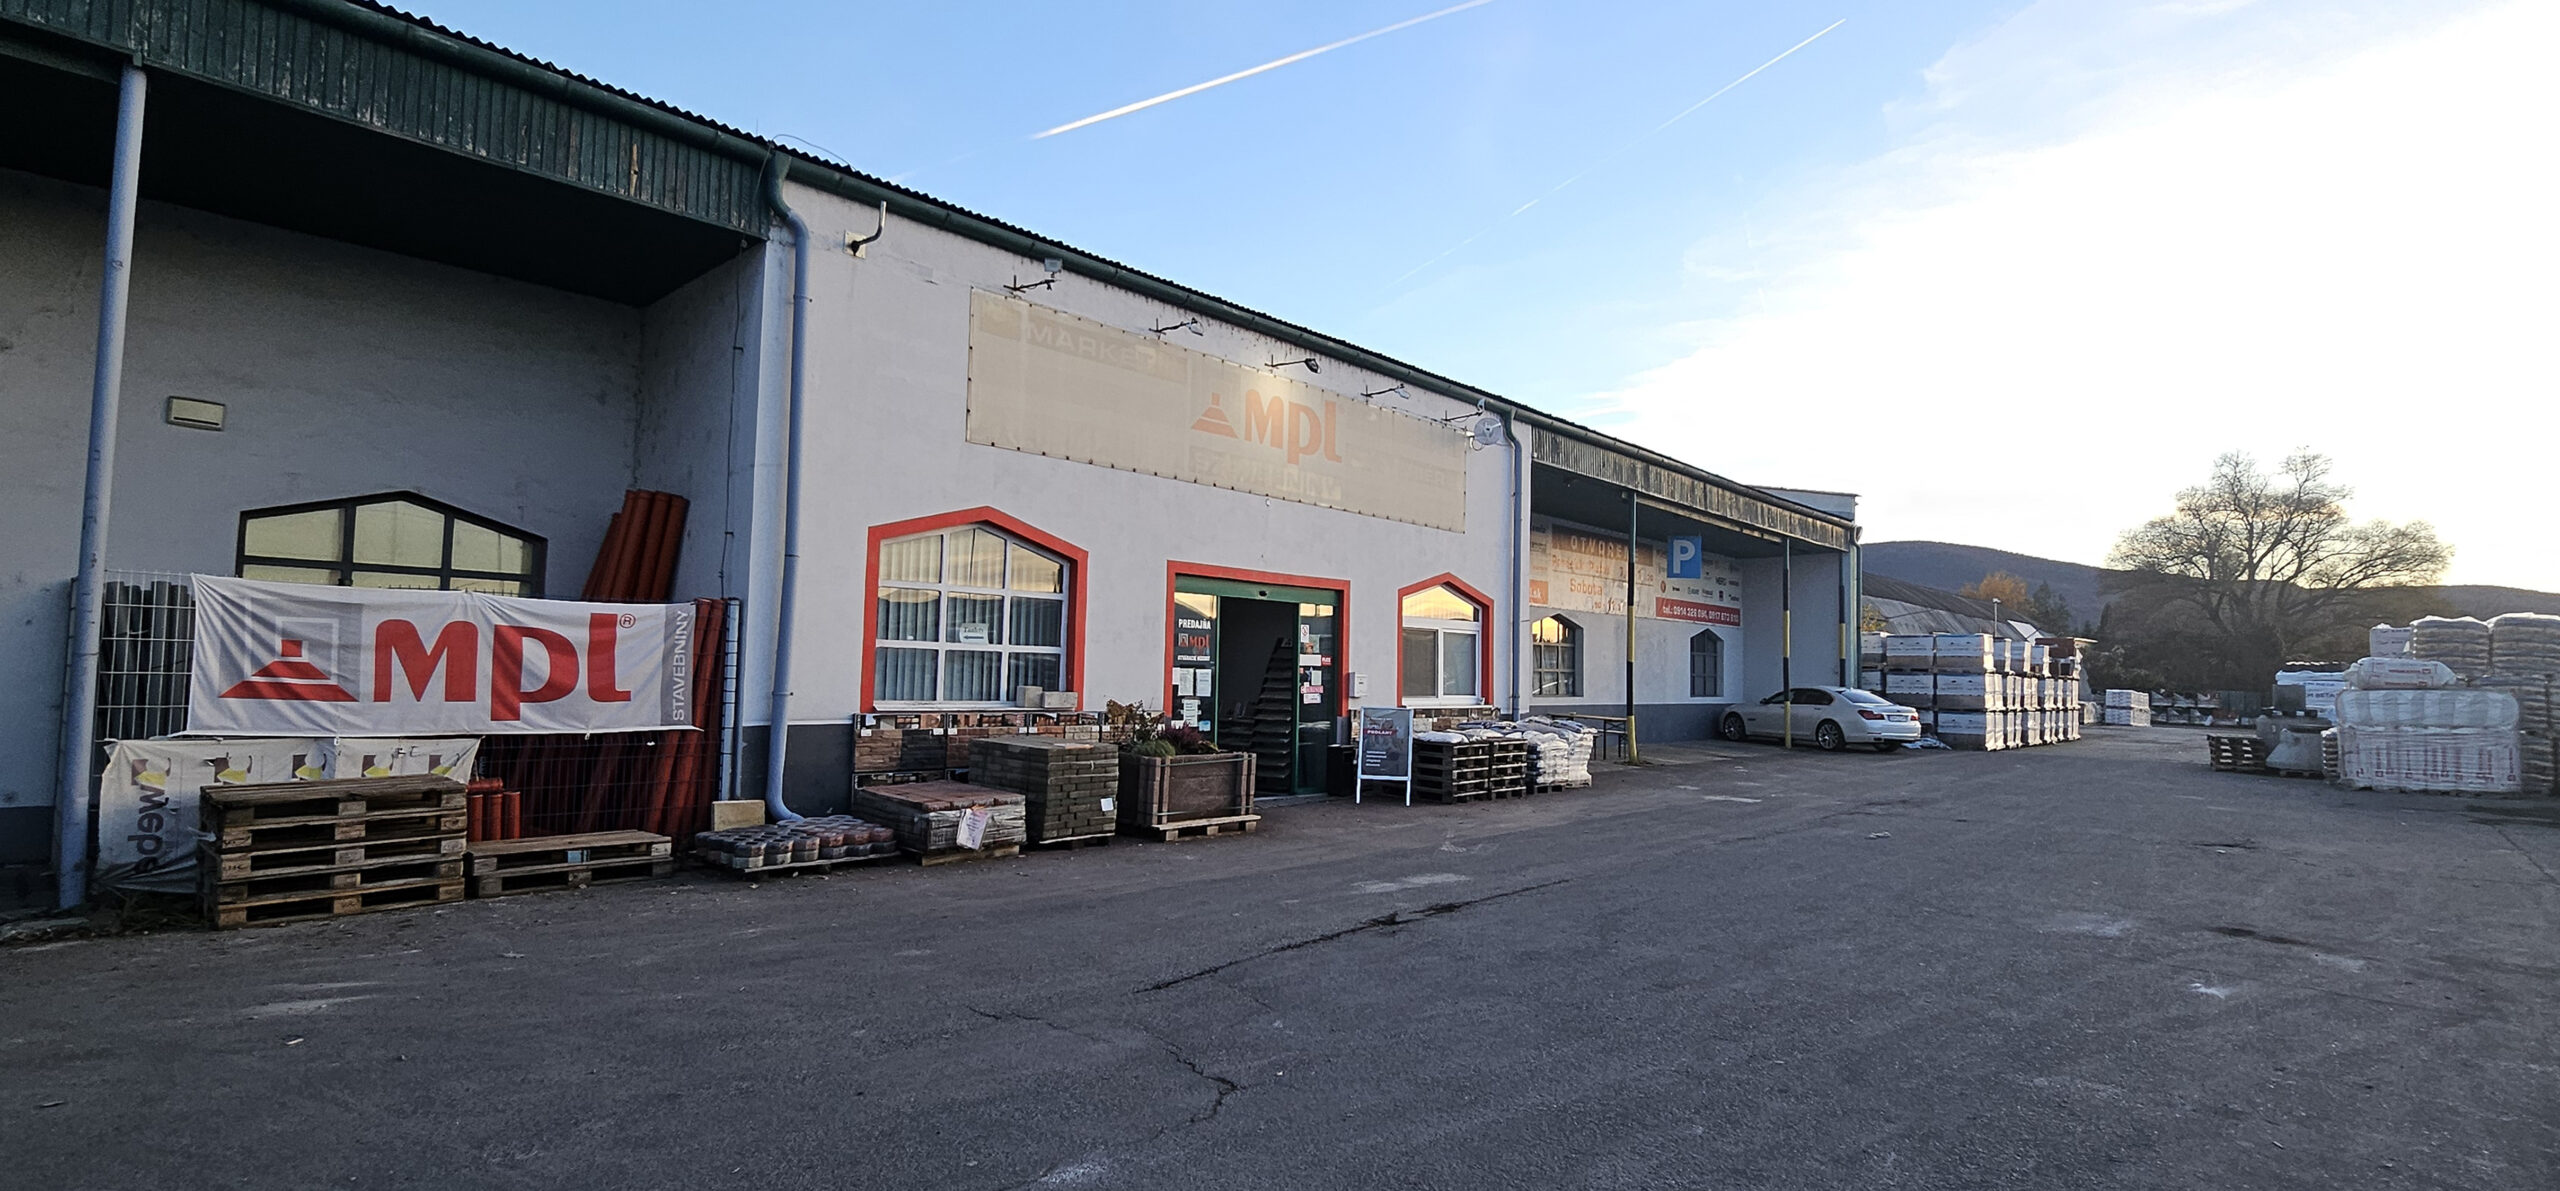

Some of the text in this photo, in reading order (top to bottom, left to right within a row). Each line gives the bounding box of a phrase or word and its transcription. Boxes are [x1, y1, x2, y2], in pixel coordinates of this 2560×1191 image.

[1673, 539, 1696, 574] P
[1569, 577, 1604, 597] Sobota
[672, 610, 689, 721] STAVEBNINY
